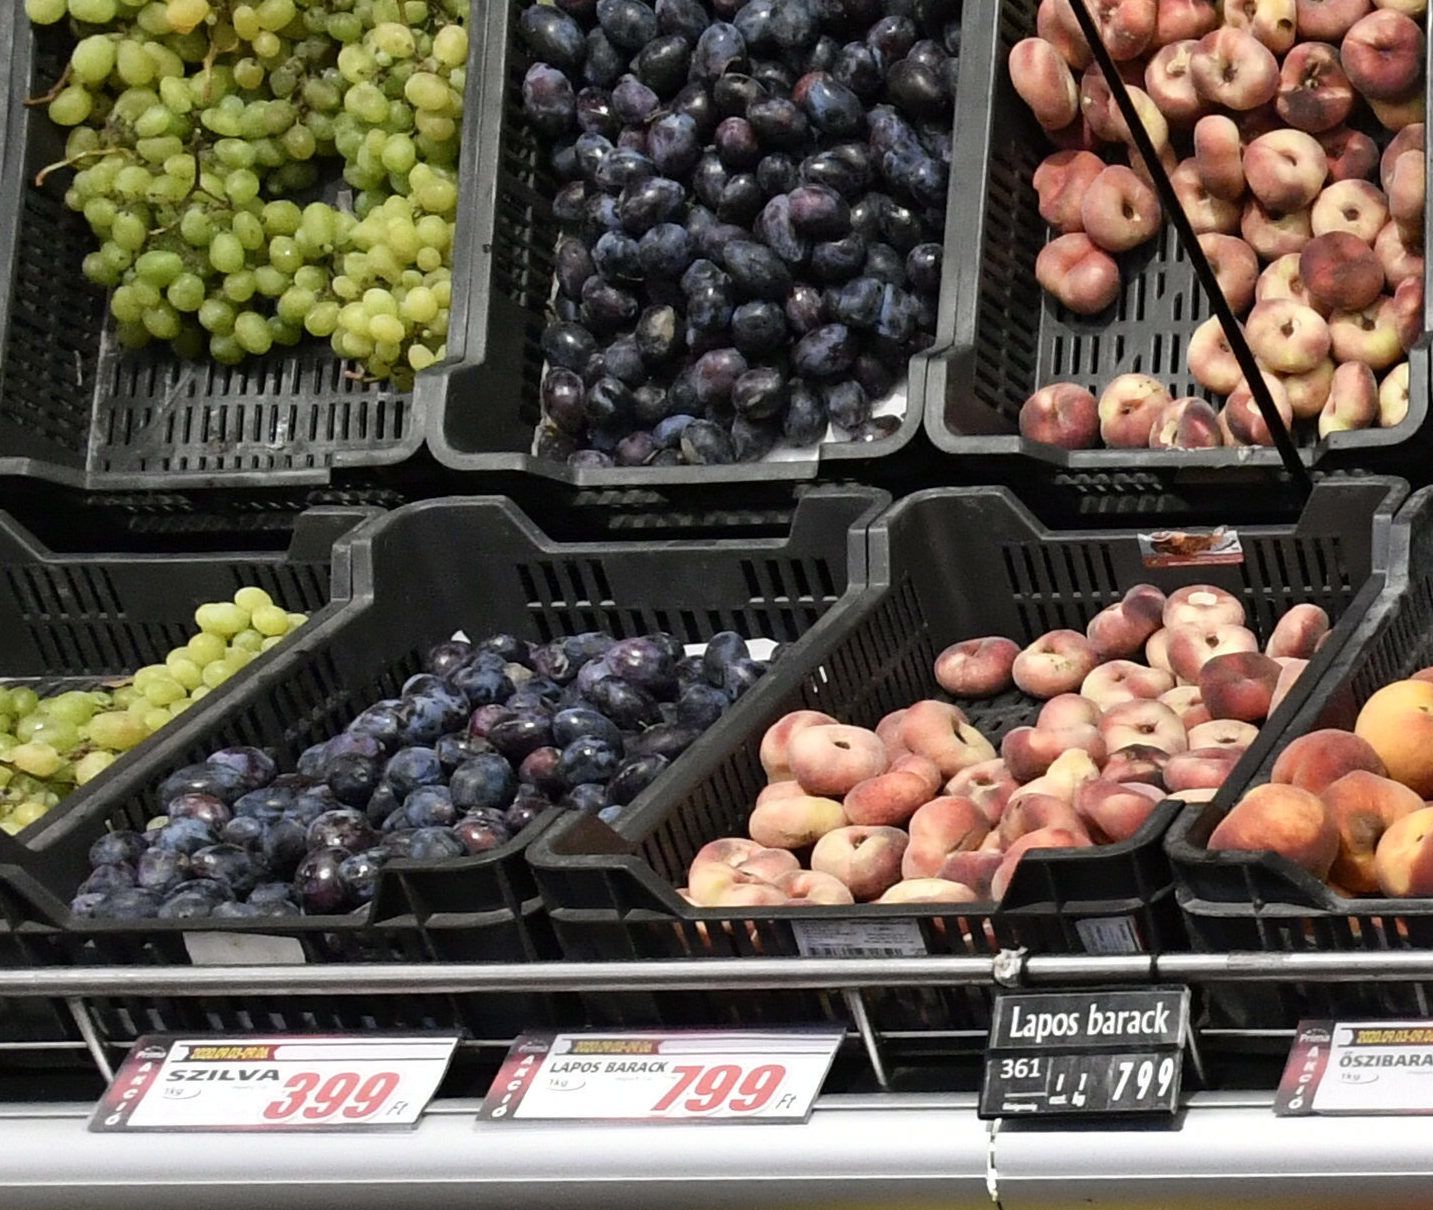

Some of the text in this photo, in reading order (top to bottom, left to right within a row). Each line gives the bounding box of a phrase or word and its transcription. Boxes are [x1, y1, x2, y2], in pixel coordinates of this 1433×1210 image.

[1010, 1001, 1170, 1043] Lapos barack
[166, 1069, 280, 1081] SZILVA
[549, 1061, 670, 1073] LAPOS BARACK
[650, 1064, 797, 1112] 799 Ft
[1000, 1058, 1041, 1079] 361
[1112, 1057, 1174, 1101] 799
[262, 1071, 408, 1120] 399 Ft
